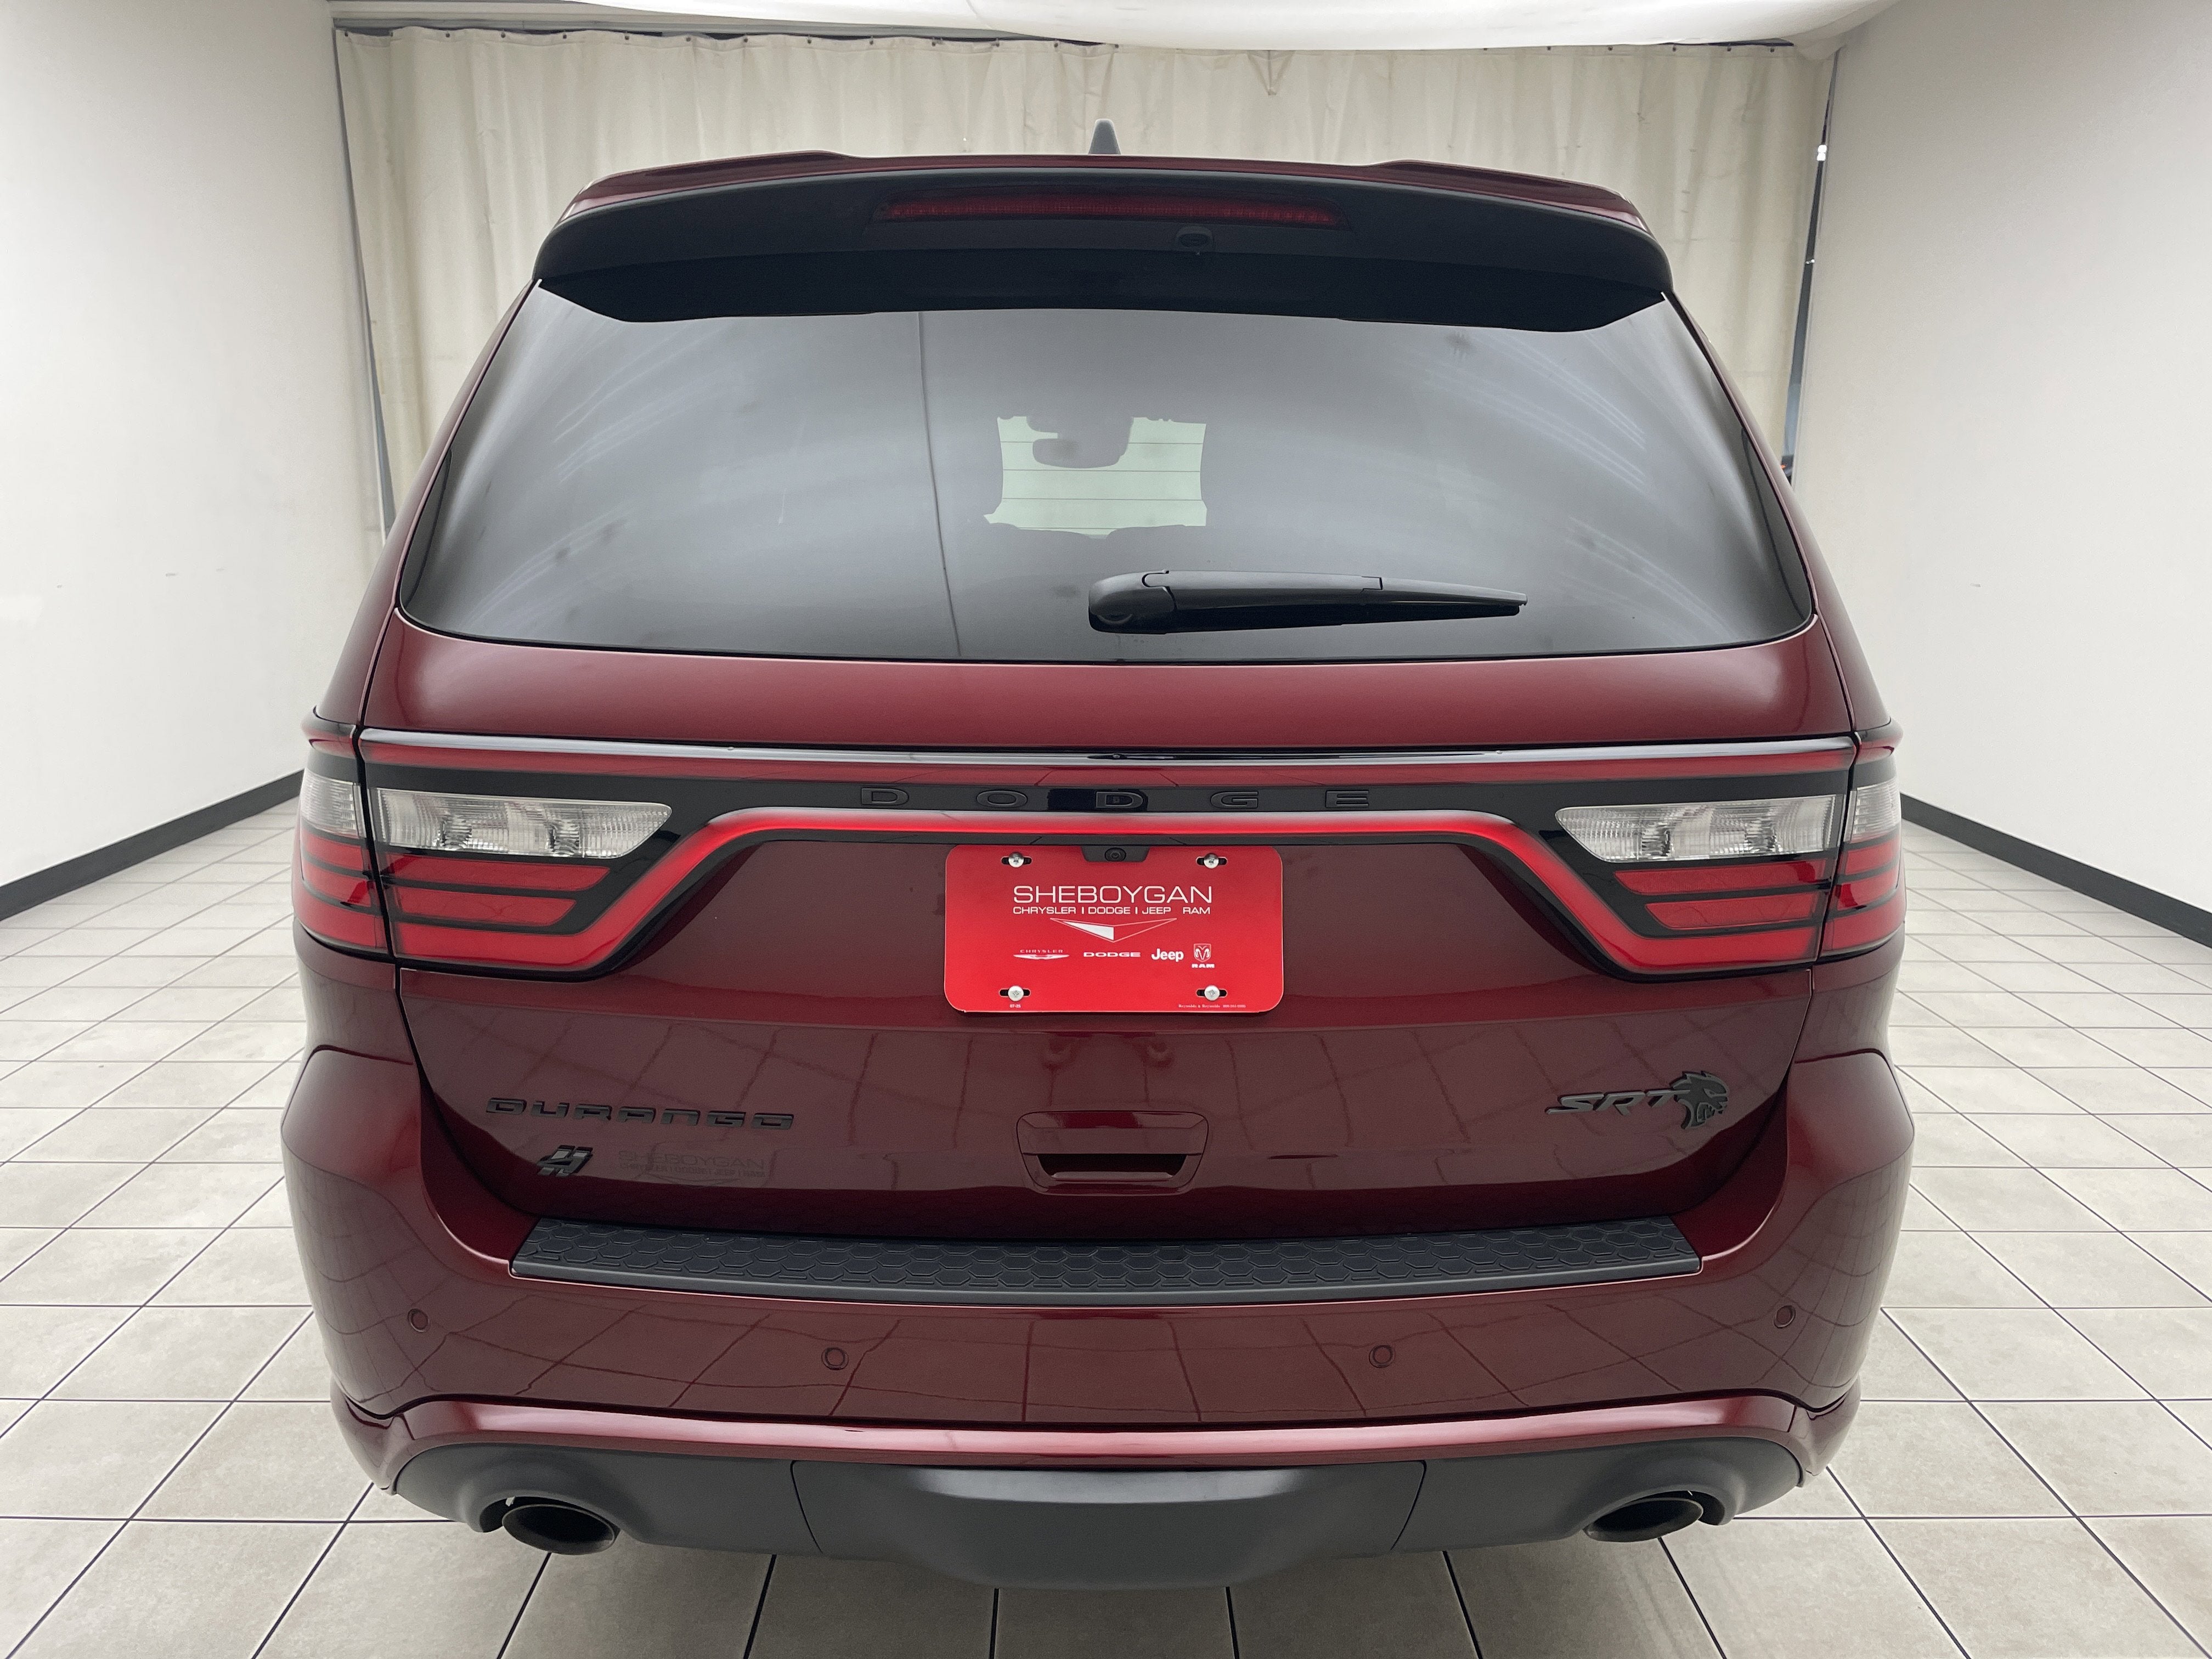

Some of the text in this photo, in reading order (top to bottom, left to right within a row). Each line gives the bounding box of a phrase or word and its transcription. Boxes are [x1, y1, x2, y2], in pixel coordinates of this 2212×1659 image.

[860, 786, 1370, 809] DODGE
[1013, 885, 1212, 904] SHEBOYGAN
[1013, 906, 1211, 915] CHRYSLER DODGE JEEP RAM
[1151, 948, 1184, 962] Jeep
[1544, 1088, 1691, 1116] SRT
[486, 1097, 794, 1131] DURANGO
[618, 1150, 764, 1170] SHEBOYGAN
